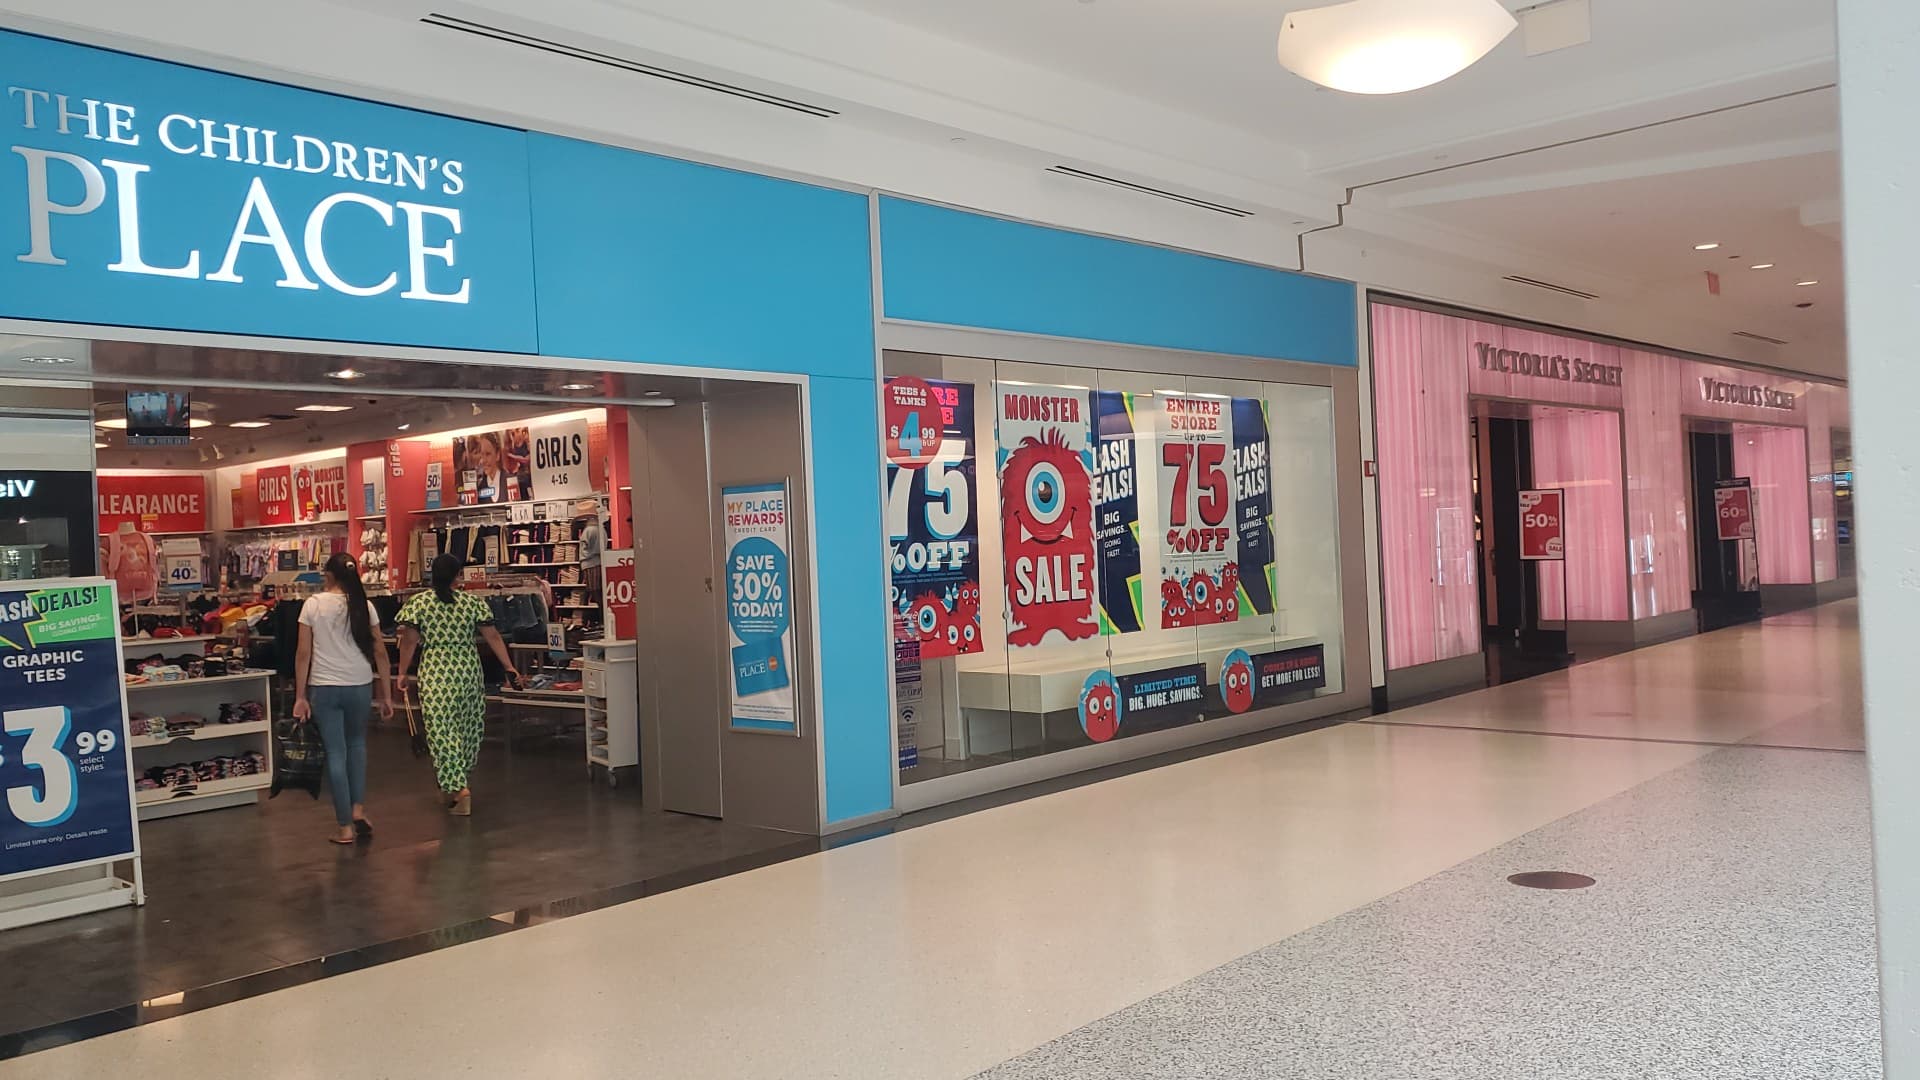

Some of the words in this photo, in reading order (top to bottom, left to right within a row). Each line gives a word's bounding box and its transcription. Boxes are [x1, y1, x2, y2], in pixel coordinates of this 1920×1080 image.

[8, 86, 139, 146] THE
[158, 114, 464, 195] CHILDREN'S
[12, 146, 471, 304] PLACE
[1475, 342, 1570, 380] VICTORIA'S
[1572, 358, 1622, 387] SECRET
[893, 386, 918, 396] TEES
[920, 388, 927, 397] &
[894, 396, 926, 407] TANKS
[1004, 394, 1079, 423] MONSTER
[1166, 398, 1221, 416] ENTIRE
[1171, 415, 1217, 431] STORE
[390, 443, 404, 477] girls
[536, 433, 582, 469] GIRLS
[1092, 439, 1130, 476] LASH
[314, 466, 344, 484] MONSTER
[551, 473, 568, 486] 4-16
[259, 475, 287, 503] GIRLS
[1092, 467, 1133, 505] EALS!
[1162, 443, 1229, 527] 75
[99, 493, 199, 515] LEARANCE
[316, 483, 346, 514] SALE
[727, 501, 743, 513] MY
[745, 500, 783, 512] PLACE
[1103, 511, 1120, 526] BIG
[1245, 505, 1258, 519] BIG
[1104, 538, 1121, 549] GOING
[1166, 528, 1230, 554] %OFF
[736, 555, 775, 570] SAVE
[171, 567, 191, 580] 40
[1014, 554, 1087, 606] SALE
[732, 572, 782, 601] 30%
[0, 600, 34, 622] ASH
[38, 586, 98, 614] DEALS!
[732, 602, 783, 618] TODAY!
[38, 623, 57, 632] BIG
[3, 650, 84, 668] GRAPHIC
[23, 668, 66, 683] TEES
[740, 663, 765, 678] PLACE
[1262, 674, 1274, 688] GET
[1275, 671, 1291, 686] MORE
[1292, 668, 1303, 682] FOR
[1303, 665, 1320, 680] LESS!
[1134, 680, 1173, 694] LIMITED
[1173, 675, 1197, 687] TIME
[1129, 695, 1146, 712] BIG.
[1146, 691, 1169, 708] HUGE.
[1170, 685, 1204, 704] SAVINGS.
[76, 729, 116, 755] 99
[80, 756, 104, 765] select
[80, 764, 104, 773] styles
[5, 840, 31, 850] Limited
[32, 838, 47, 846] time
[65, 831, 88, 840] Details
